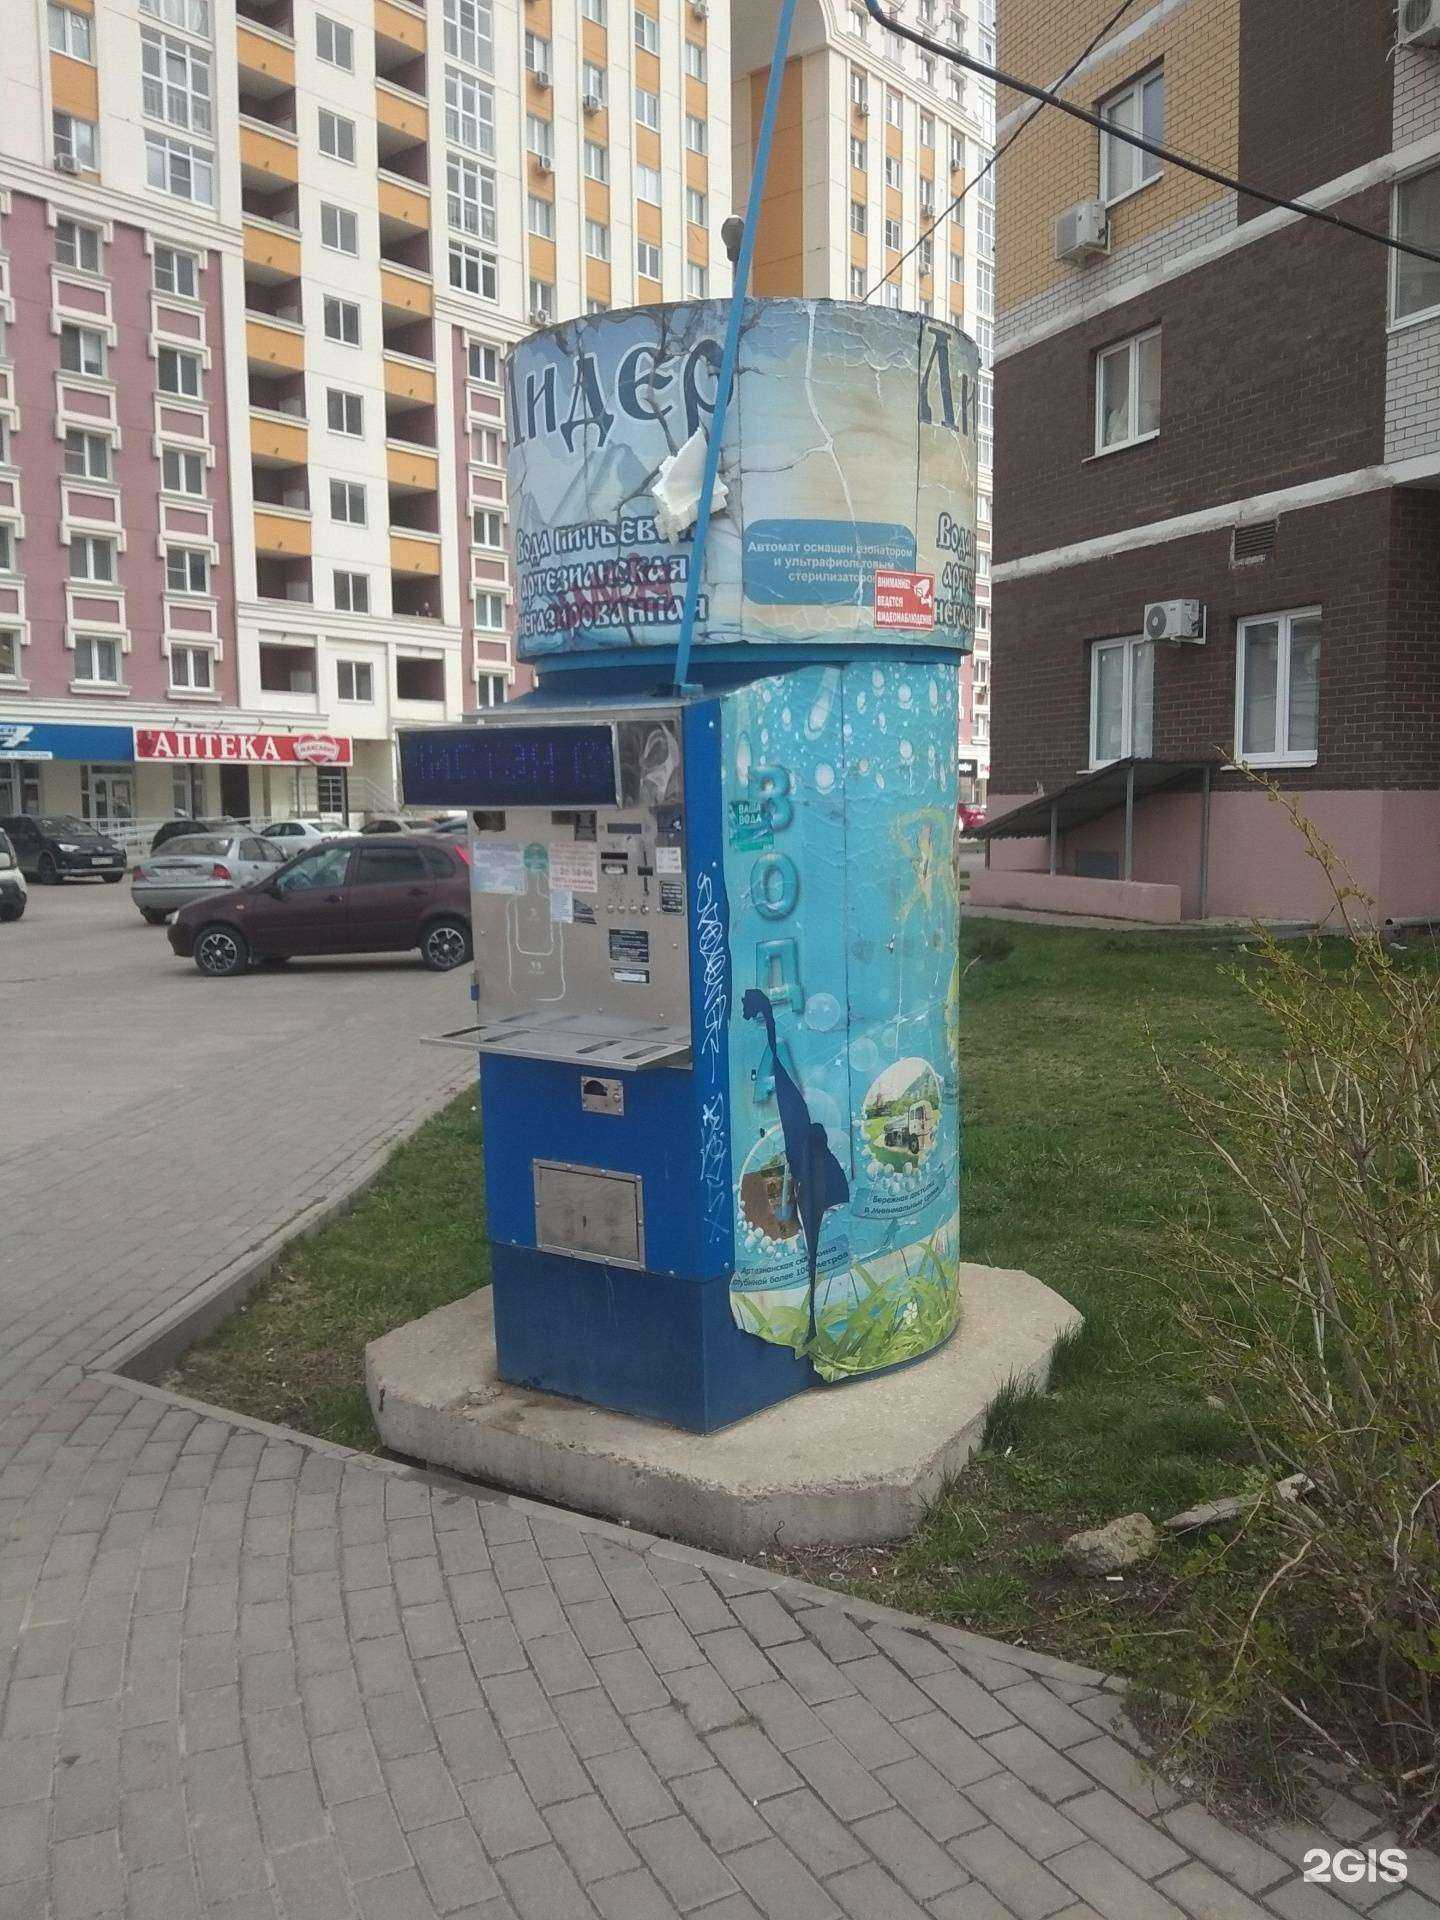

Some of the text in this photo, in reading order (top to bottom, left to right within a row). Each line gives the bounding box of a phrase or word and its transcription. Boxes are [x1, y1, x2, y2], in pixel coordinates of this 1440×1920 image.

[747, 541, 800, 553] Автомат
[803, 544, 853, 555] оснащен
[774, 558, 781, 566] и
[788, 571, 876, 584] стерилизаторо
[877, 595, 904, 608] ВЕДЕТСЯ
[877, 611, 932, 626] ВИДЕОНАБЛЮДЕНИЕ
[152, 733, 281, 760] АПТЕКА
[739, 814, 762, 825] ВОДА
[769, 1271, 794, 1284] более
